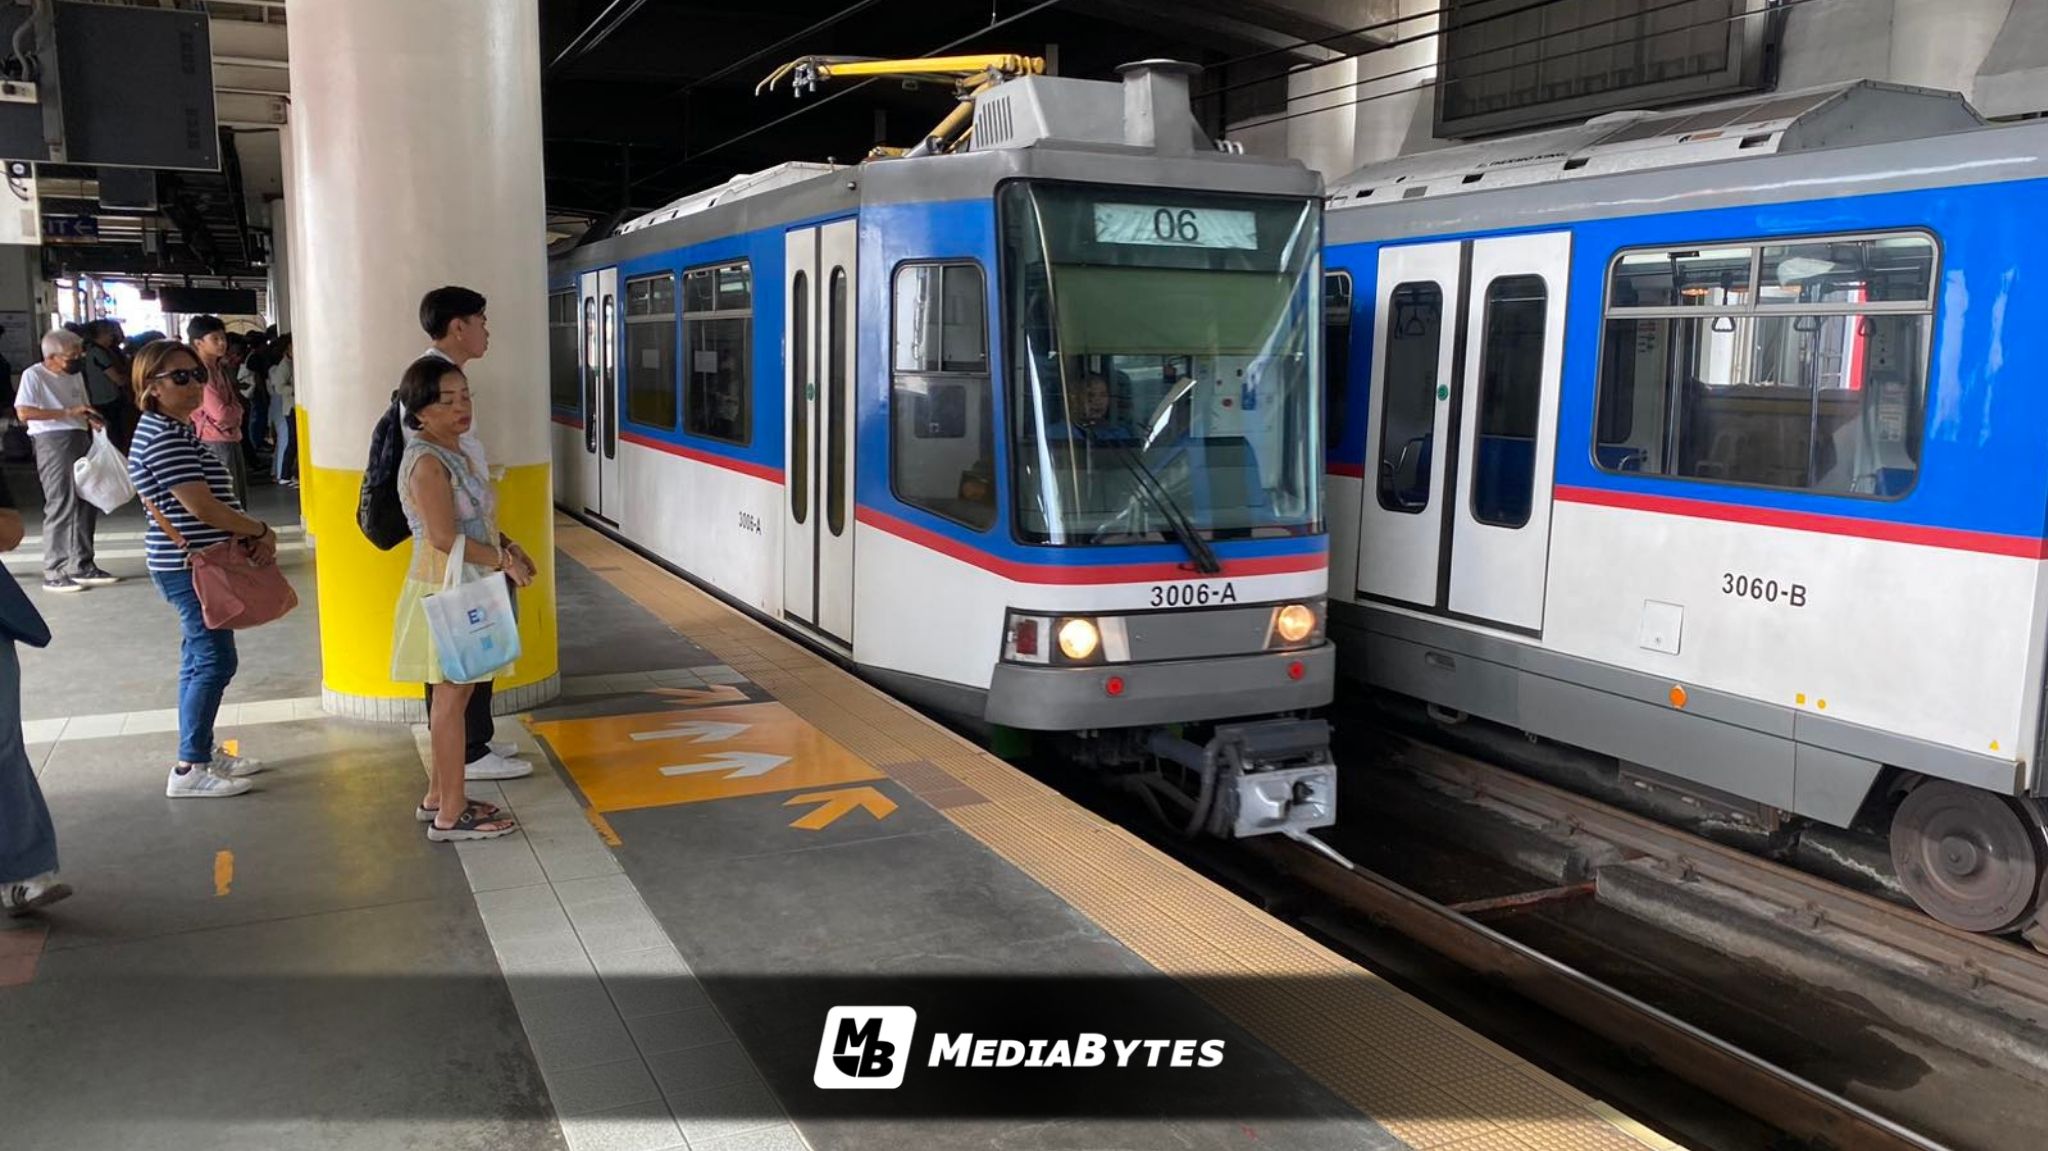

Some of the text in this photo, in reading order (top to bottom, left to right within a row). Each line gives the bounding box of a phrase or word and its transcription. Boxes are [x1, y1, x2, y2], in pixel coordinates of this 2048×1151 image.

[1154, 208, 1198, 242] 06
[1151, 582, 1236, 607] 3006-A
[1722, 573, 1806, 607] 3060-B
